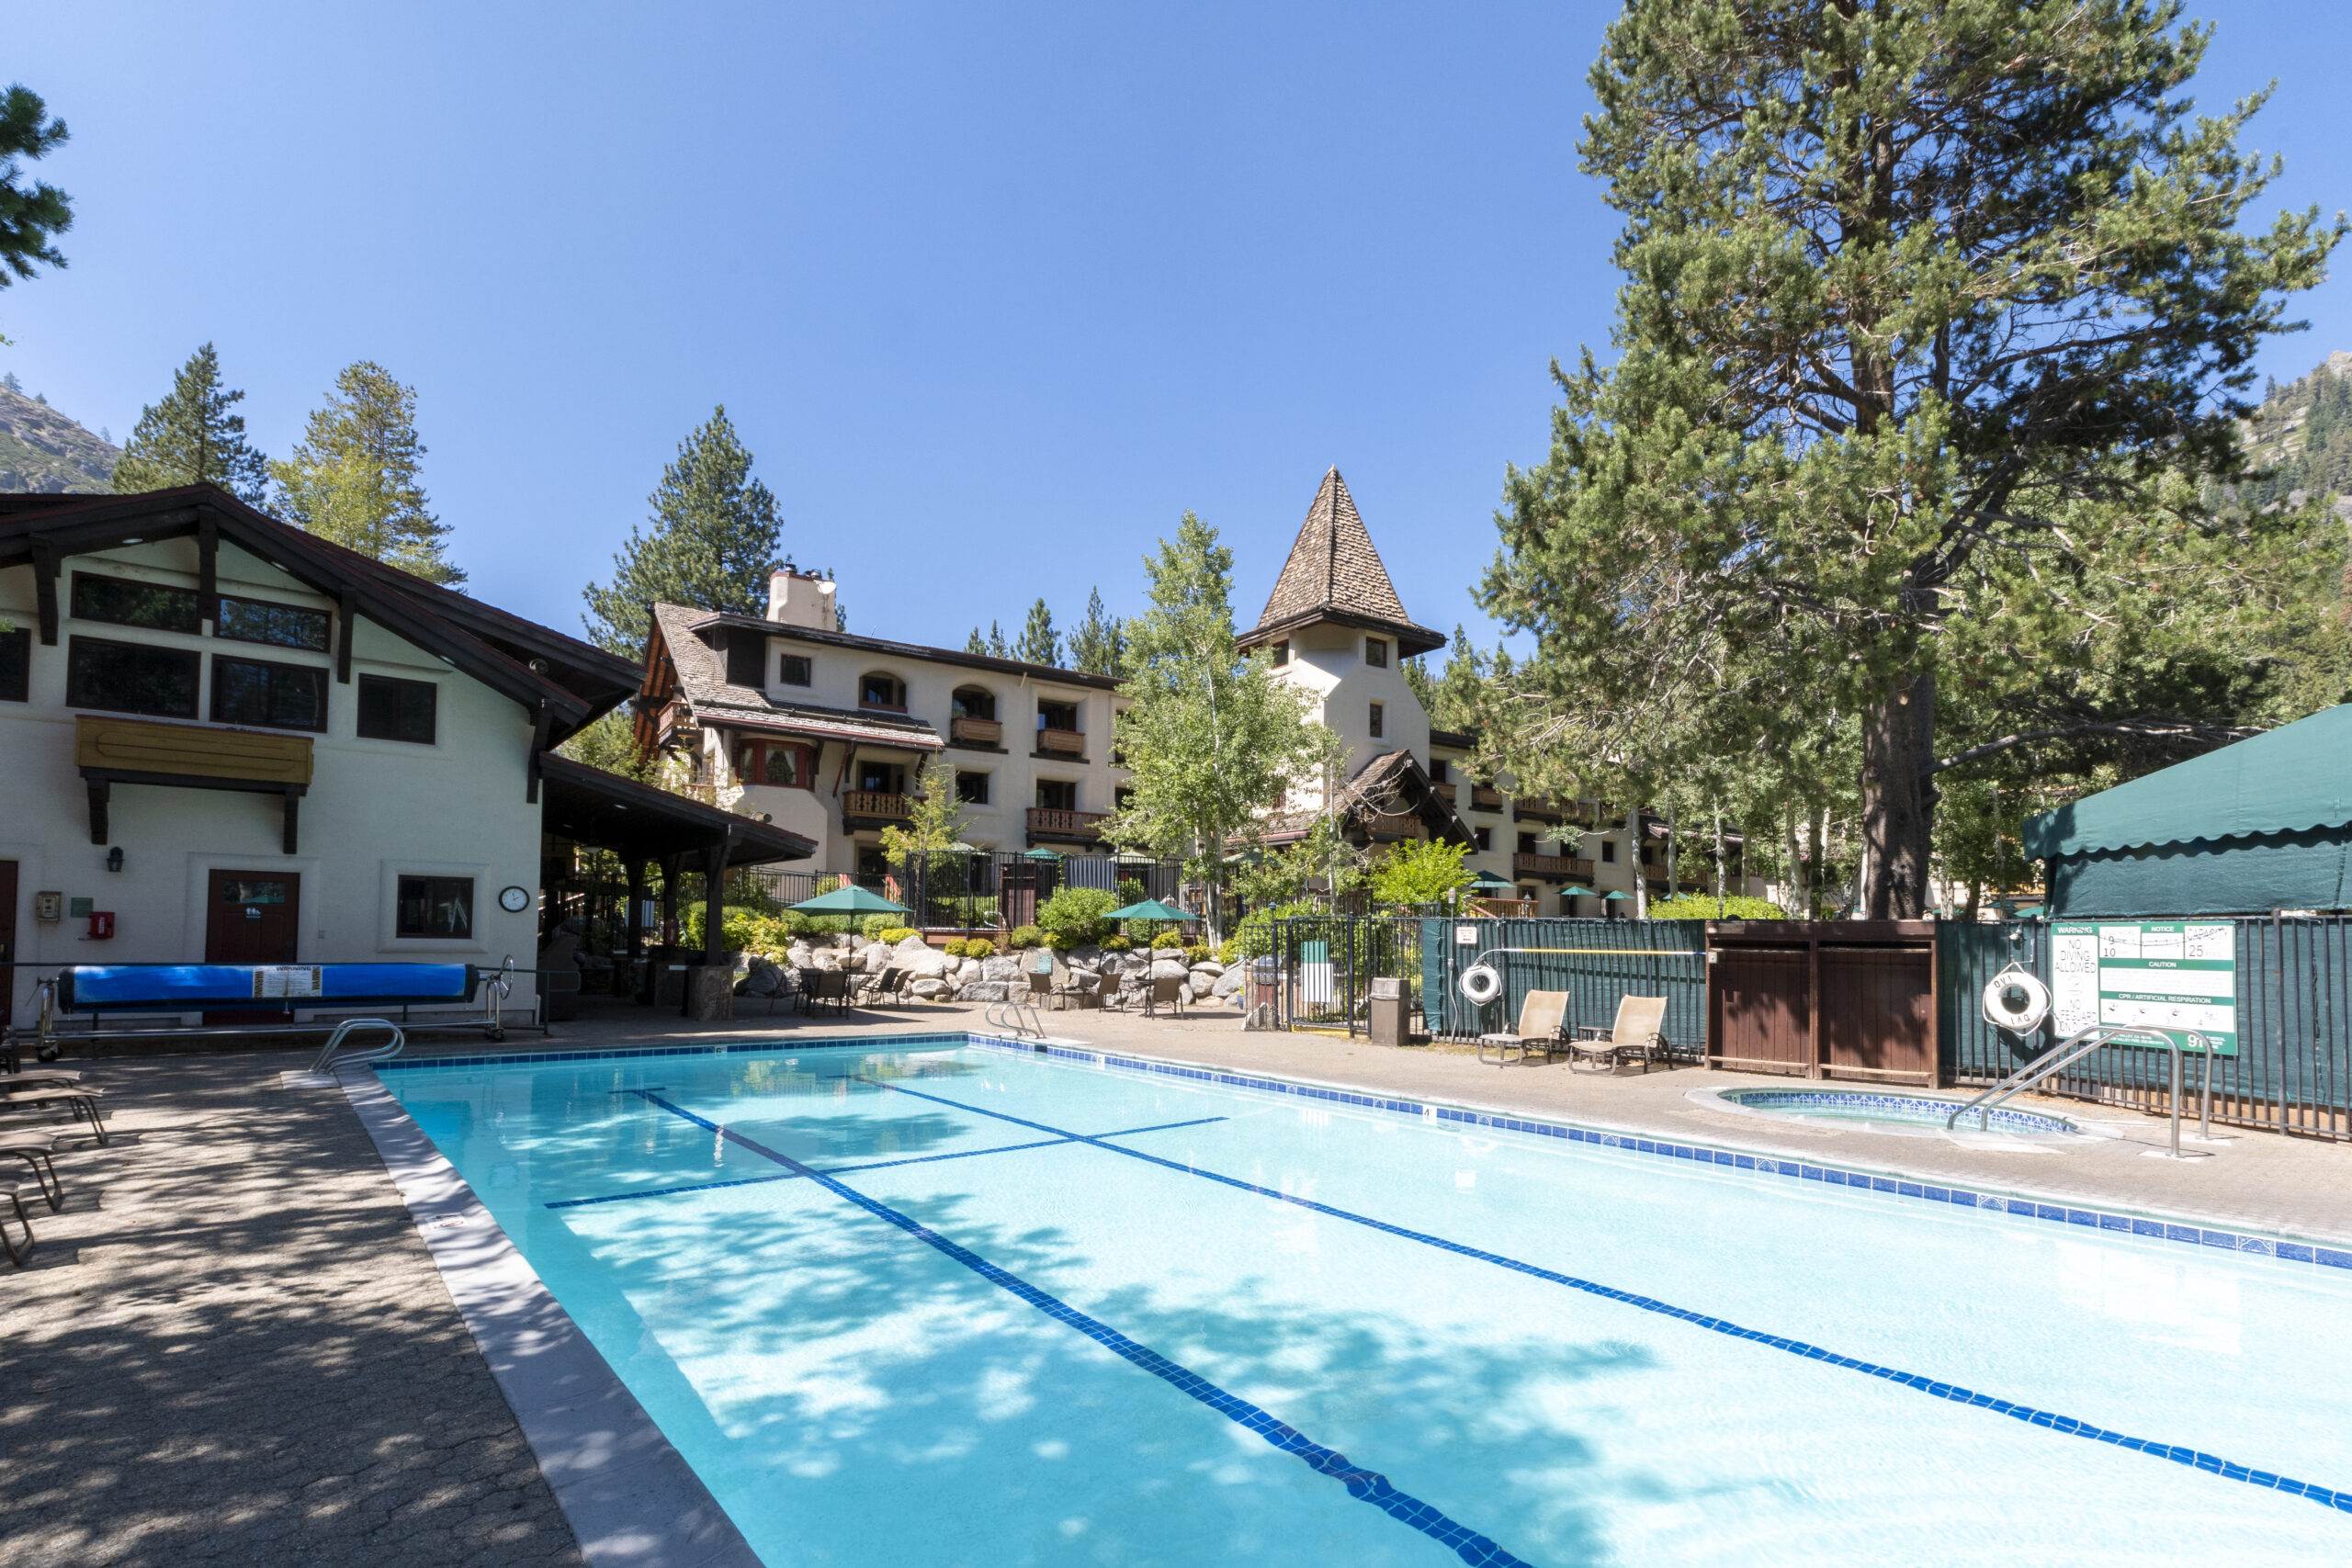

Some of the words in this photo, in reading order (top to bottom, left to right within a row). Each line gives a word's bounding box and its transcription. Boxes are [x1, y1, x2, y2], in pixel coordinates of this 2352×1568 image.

[2068, 939, 2082, 950] NO
[2188, 944, 2204, 957] 25
[2060, 950, 2090, 962] DIVING
[2103, 947, 2116, 957] 10
[2054, 962, 2097, 974] ALLOWED
[2069, 998, 2081, 1010] NO
[2135, 994, 2167, 1002] ARTIFICIAL
[2168, 996, 2211, 1004] RESPIRATION
